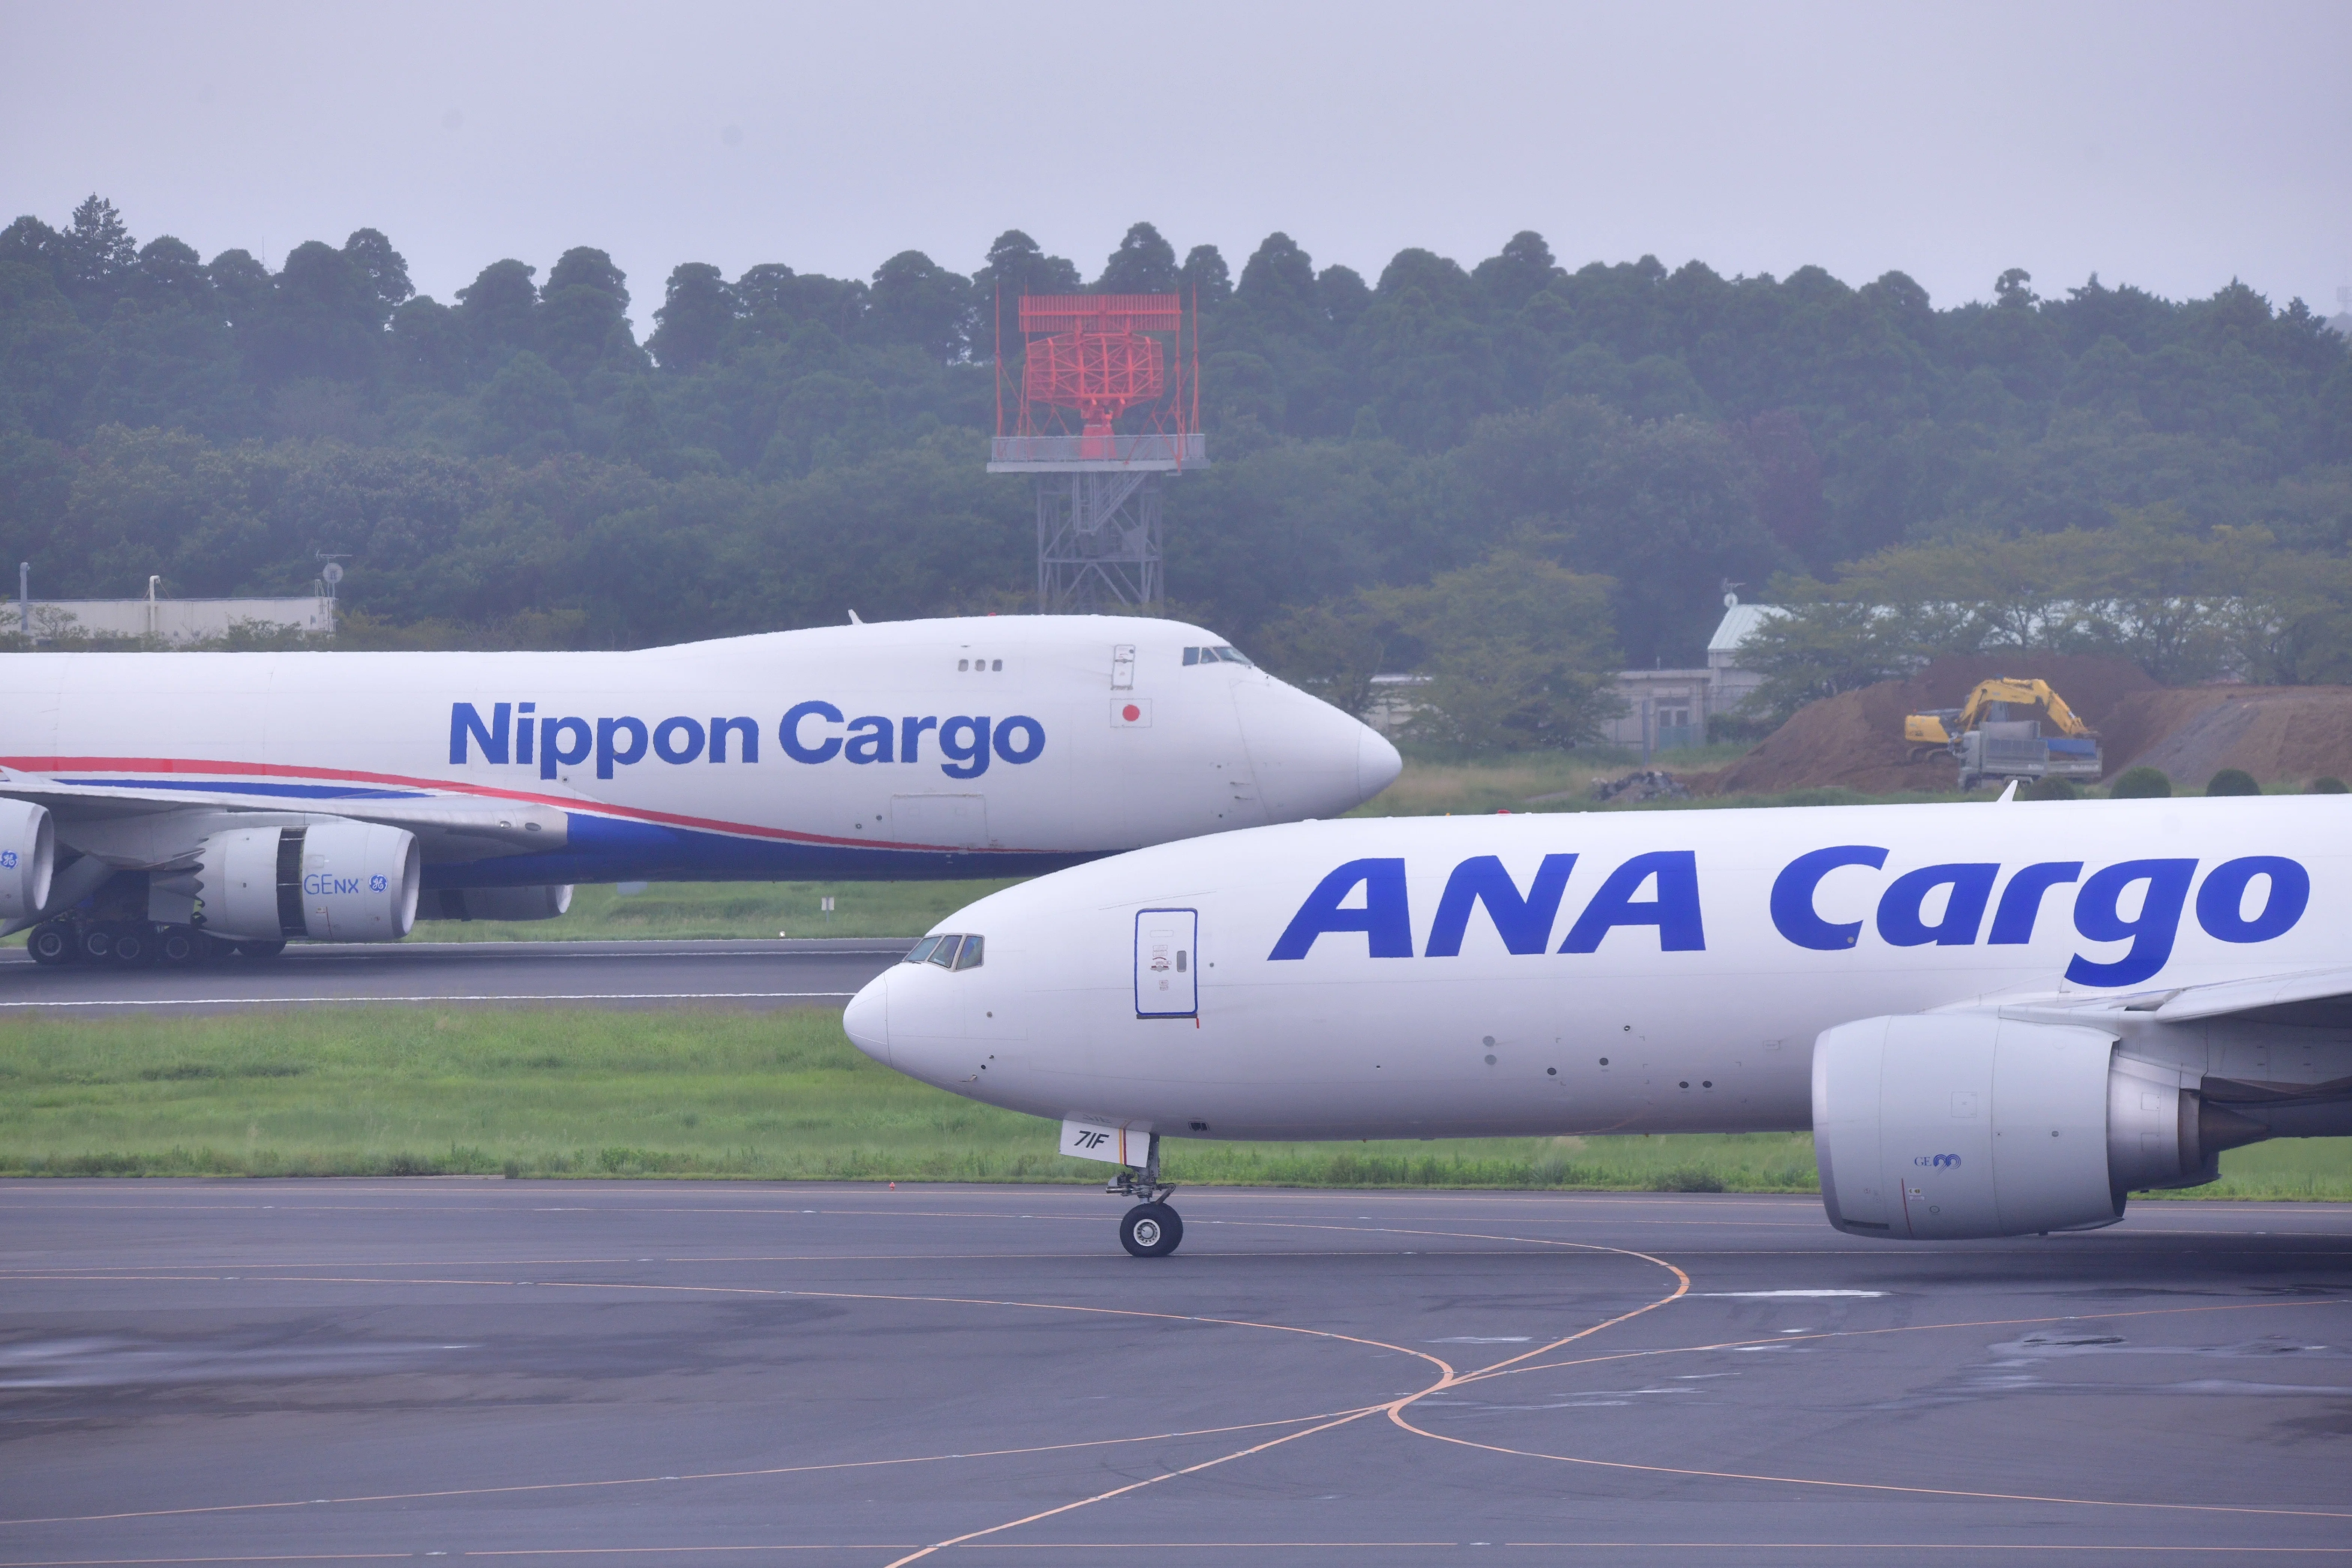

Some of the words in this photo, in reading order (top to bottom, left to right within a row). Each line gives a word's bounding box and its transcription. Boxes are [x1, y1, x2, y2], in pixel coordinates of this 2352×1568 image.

[450, 703, 759, 780] Nippon
[779, 701, 1045, 779] Cargo
[1268, 851, 1706, 960] ANA
[1771, 845, 2310, 987] Cargo
[1074, 1130, 1110, 1149] 71F
